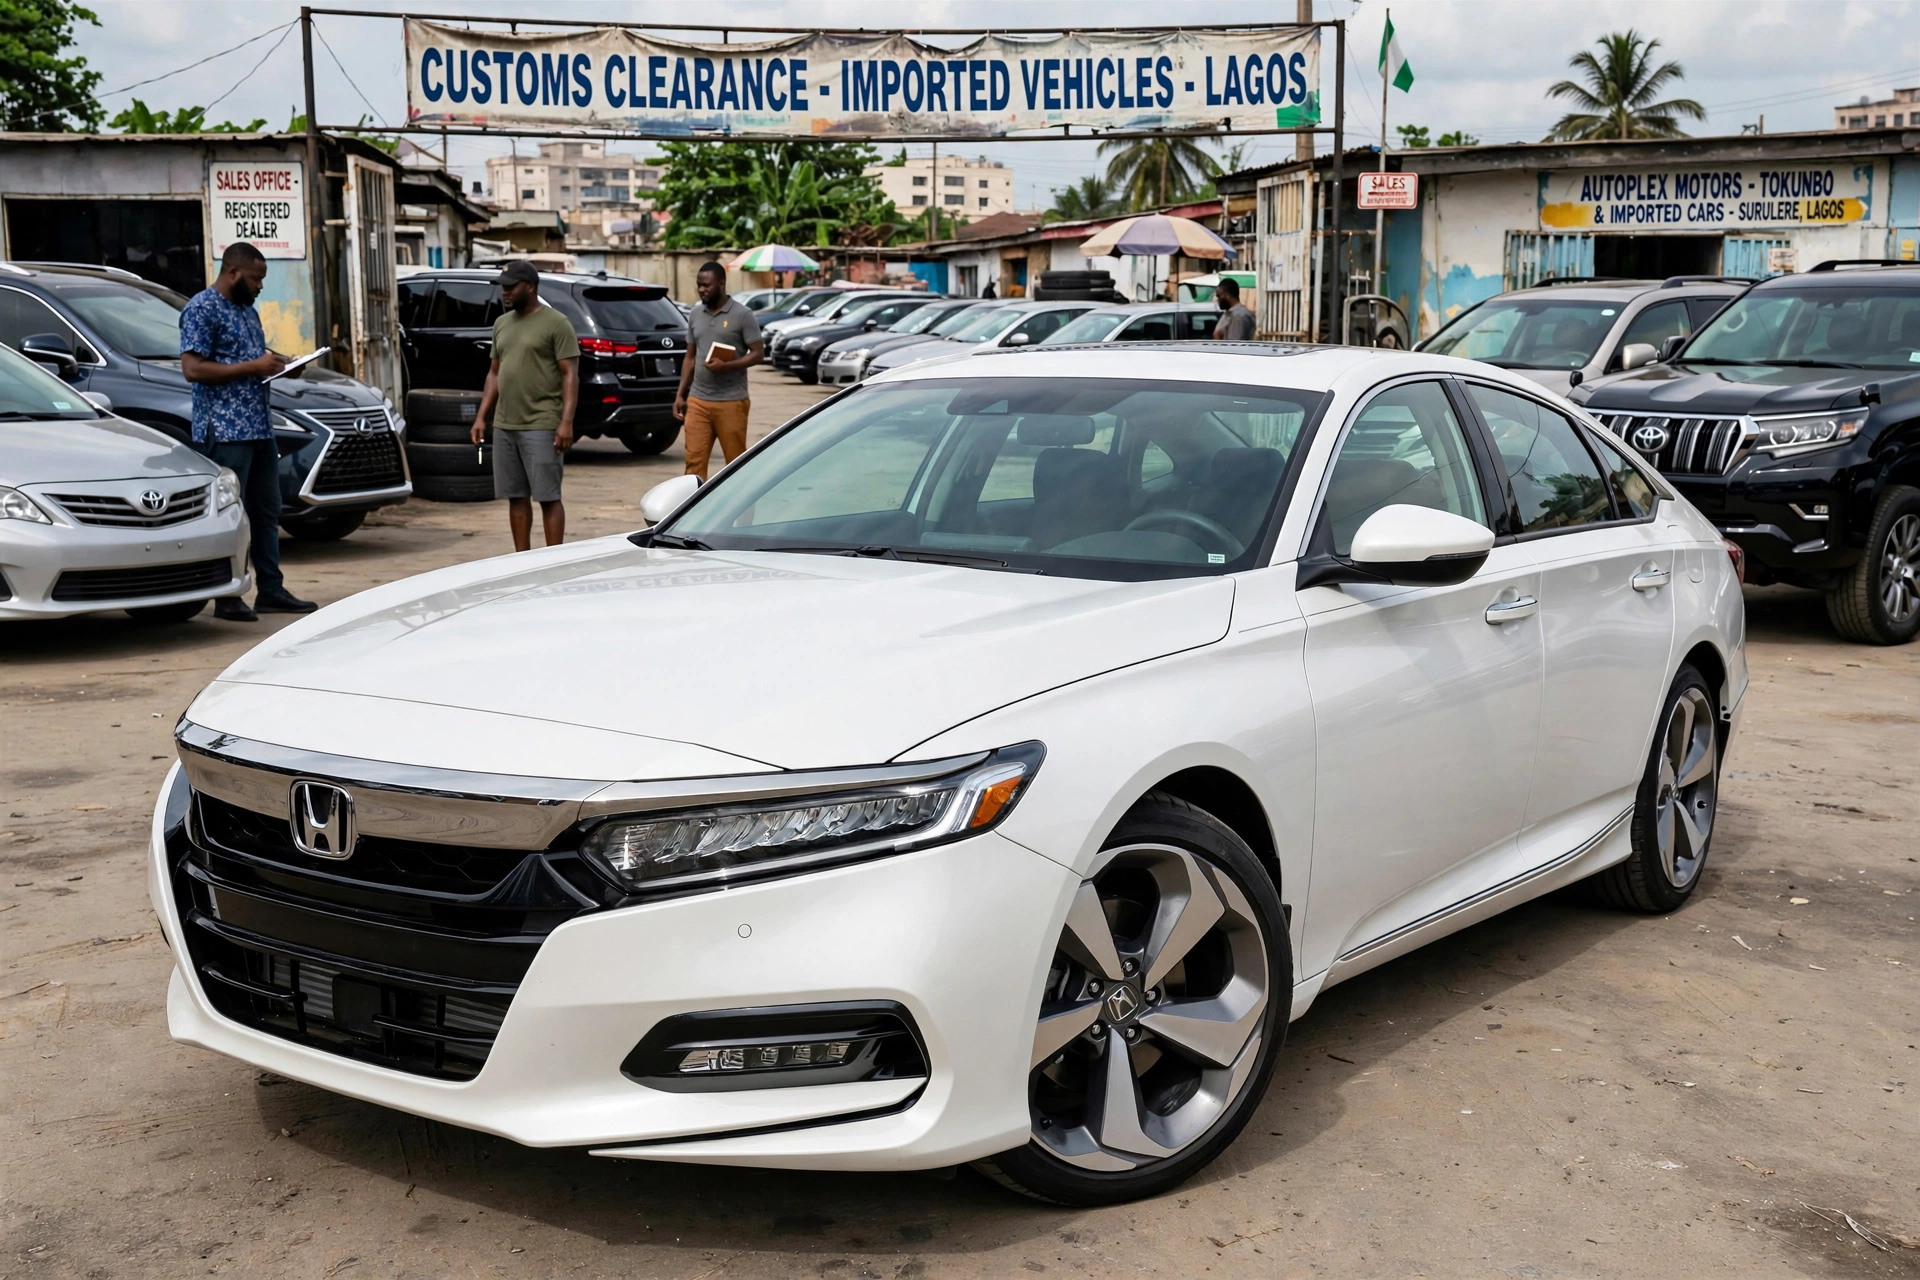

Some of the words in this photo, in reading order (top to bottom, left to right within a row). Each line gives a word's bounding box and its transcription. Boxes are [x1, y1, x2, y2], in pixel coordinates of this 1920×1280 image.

[421, 47, 593, 108] CUSTOMS
[604, 54, 809, 112] CLEARANCE
[841, 59, 1010, 113] IMPORTED
[1020, 55, 1174, 110] VEHICLES
[1205, 52, 1307, 106] LAGOS
[216, 170, 250, 191] SALES
[253, 171, 292, 191] OFFICE
[1580, 174, 1668, 202] AUTOPLEX
[1674, 172, 1742, 200] MOTORS
[1759, 170, 1834, 198] TOKUNBO
[224, 202, 290, 219] REGISTERED
[1594, 205, 1604, 224] &
[1610, 204, 1682, 224] IMPORTED
[1687, 203, 1724, 222] CARS
[1738, 201, 1803, 223] SURULERE,
[1806, 199, 1844, 220] LAGOS
[236, 221, 278, 239] DEALER
